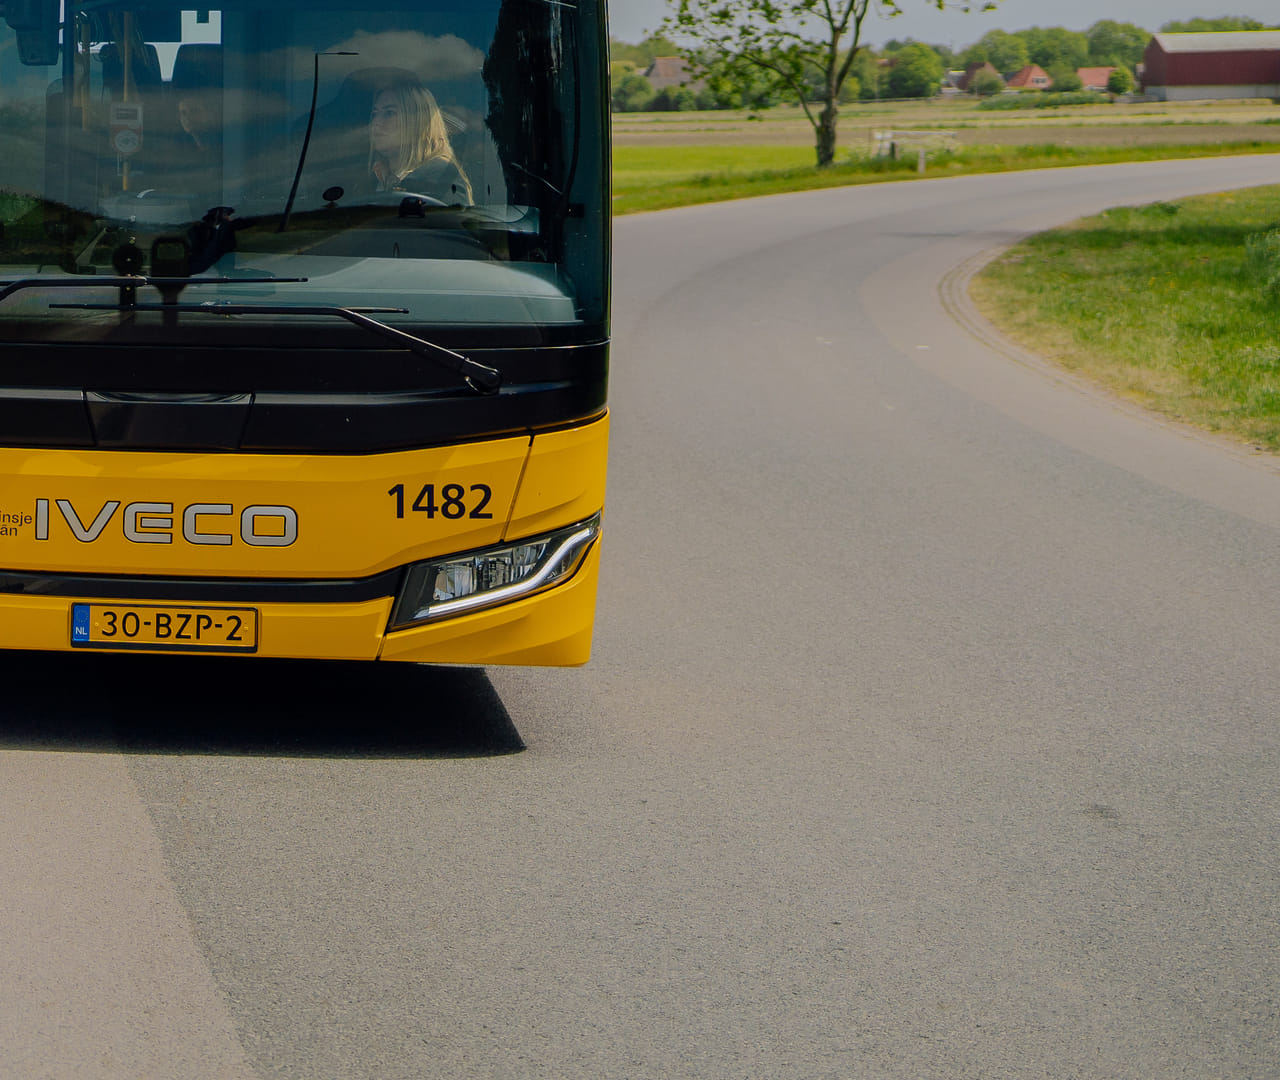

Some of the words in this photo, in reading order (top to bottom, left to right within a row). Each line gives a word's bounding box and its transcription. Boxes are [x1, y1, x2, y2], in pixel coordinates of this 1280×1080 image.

[387, 483, 493, 519] 1482
[35, 498, 298, 547] IVECO
[75, 626, 88, 636] NL
[101, 611, 243, 641] 30-BZP-2
